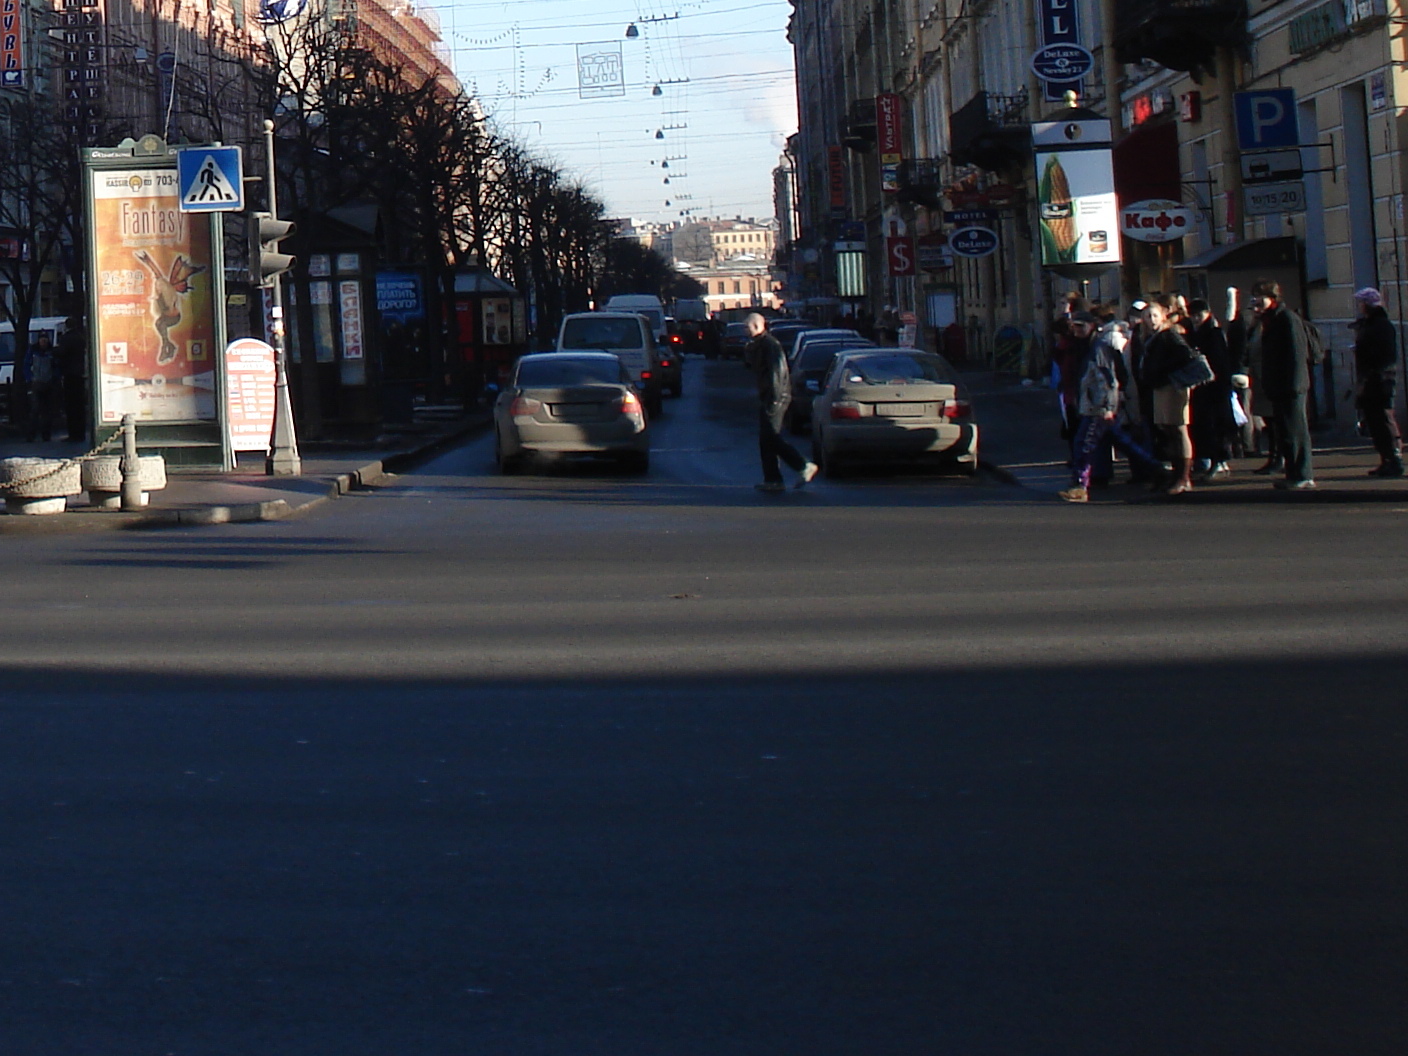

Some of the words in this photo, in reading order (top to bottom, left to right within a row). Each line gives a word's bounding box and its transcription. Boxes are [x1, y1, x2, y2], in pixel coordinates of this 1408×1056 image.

[1250, 95, 1284, 143] P
[123, 203, 184, 242] Fantasy
[1125, 211, 1186, 232] Кафе
